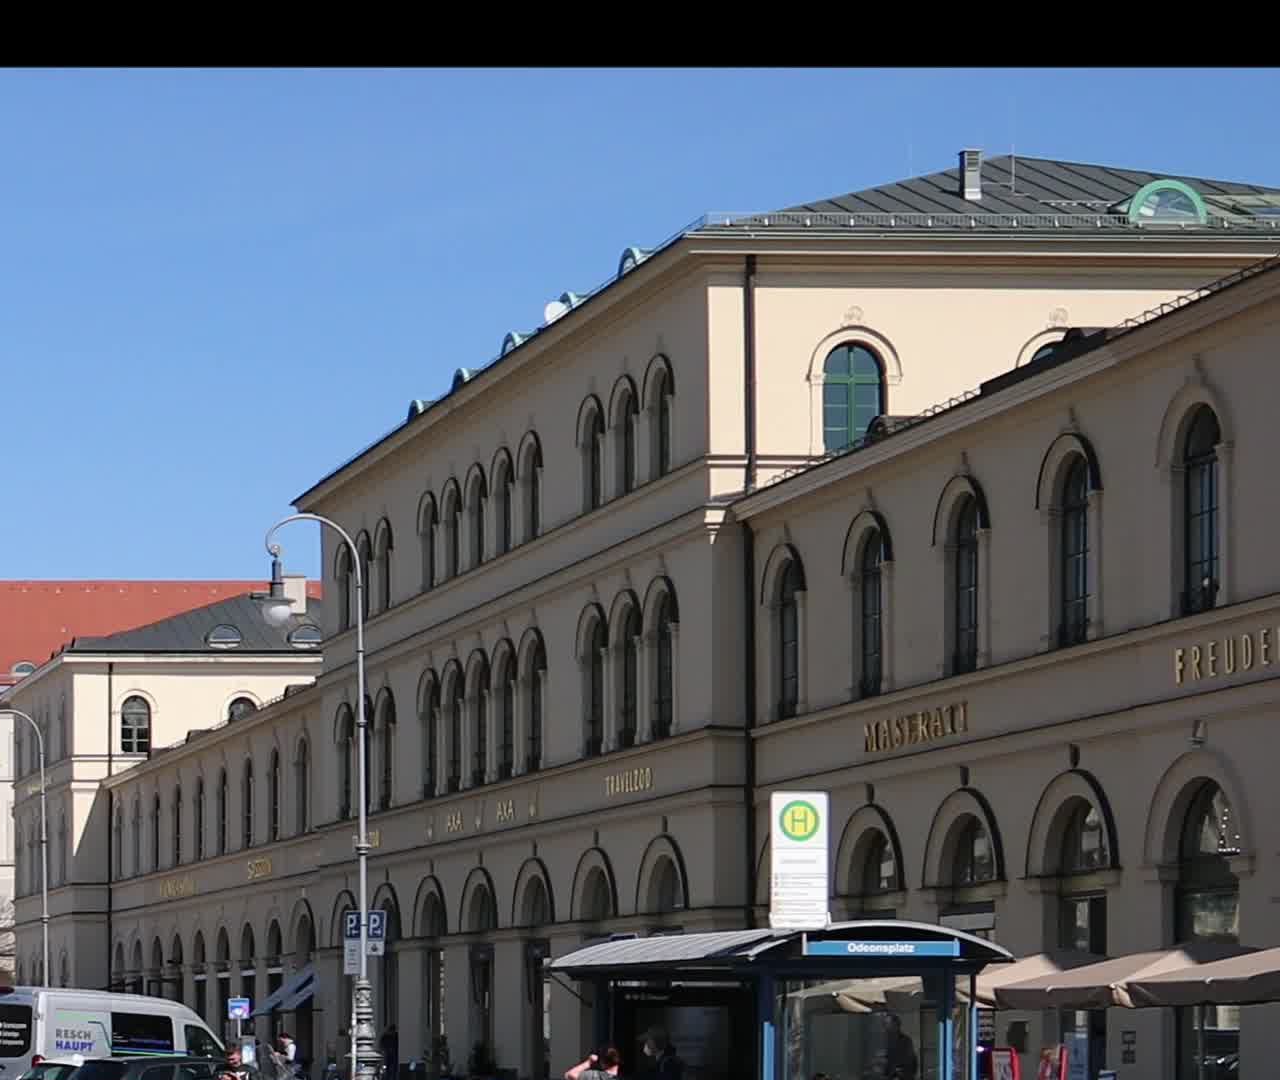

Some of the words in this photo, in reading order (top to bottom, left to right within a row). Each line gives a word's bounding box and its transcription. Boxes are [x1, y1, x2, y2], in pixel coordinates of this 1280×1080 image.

[1175, 628, 1280, 684] FREUDE
[863, 701, 968, 752] MASERATI
[496, 800, 514, 822] AXA
[847, 942, 915, 954] Odeonsplatz
[55, 1028, 92, 1040] RESCH
[55, 1040, 94, 1051] HAUPT
